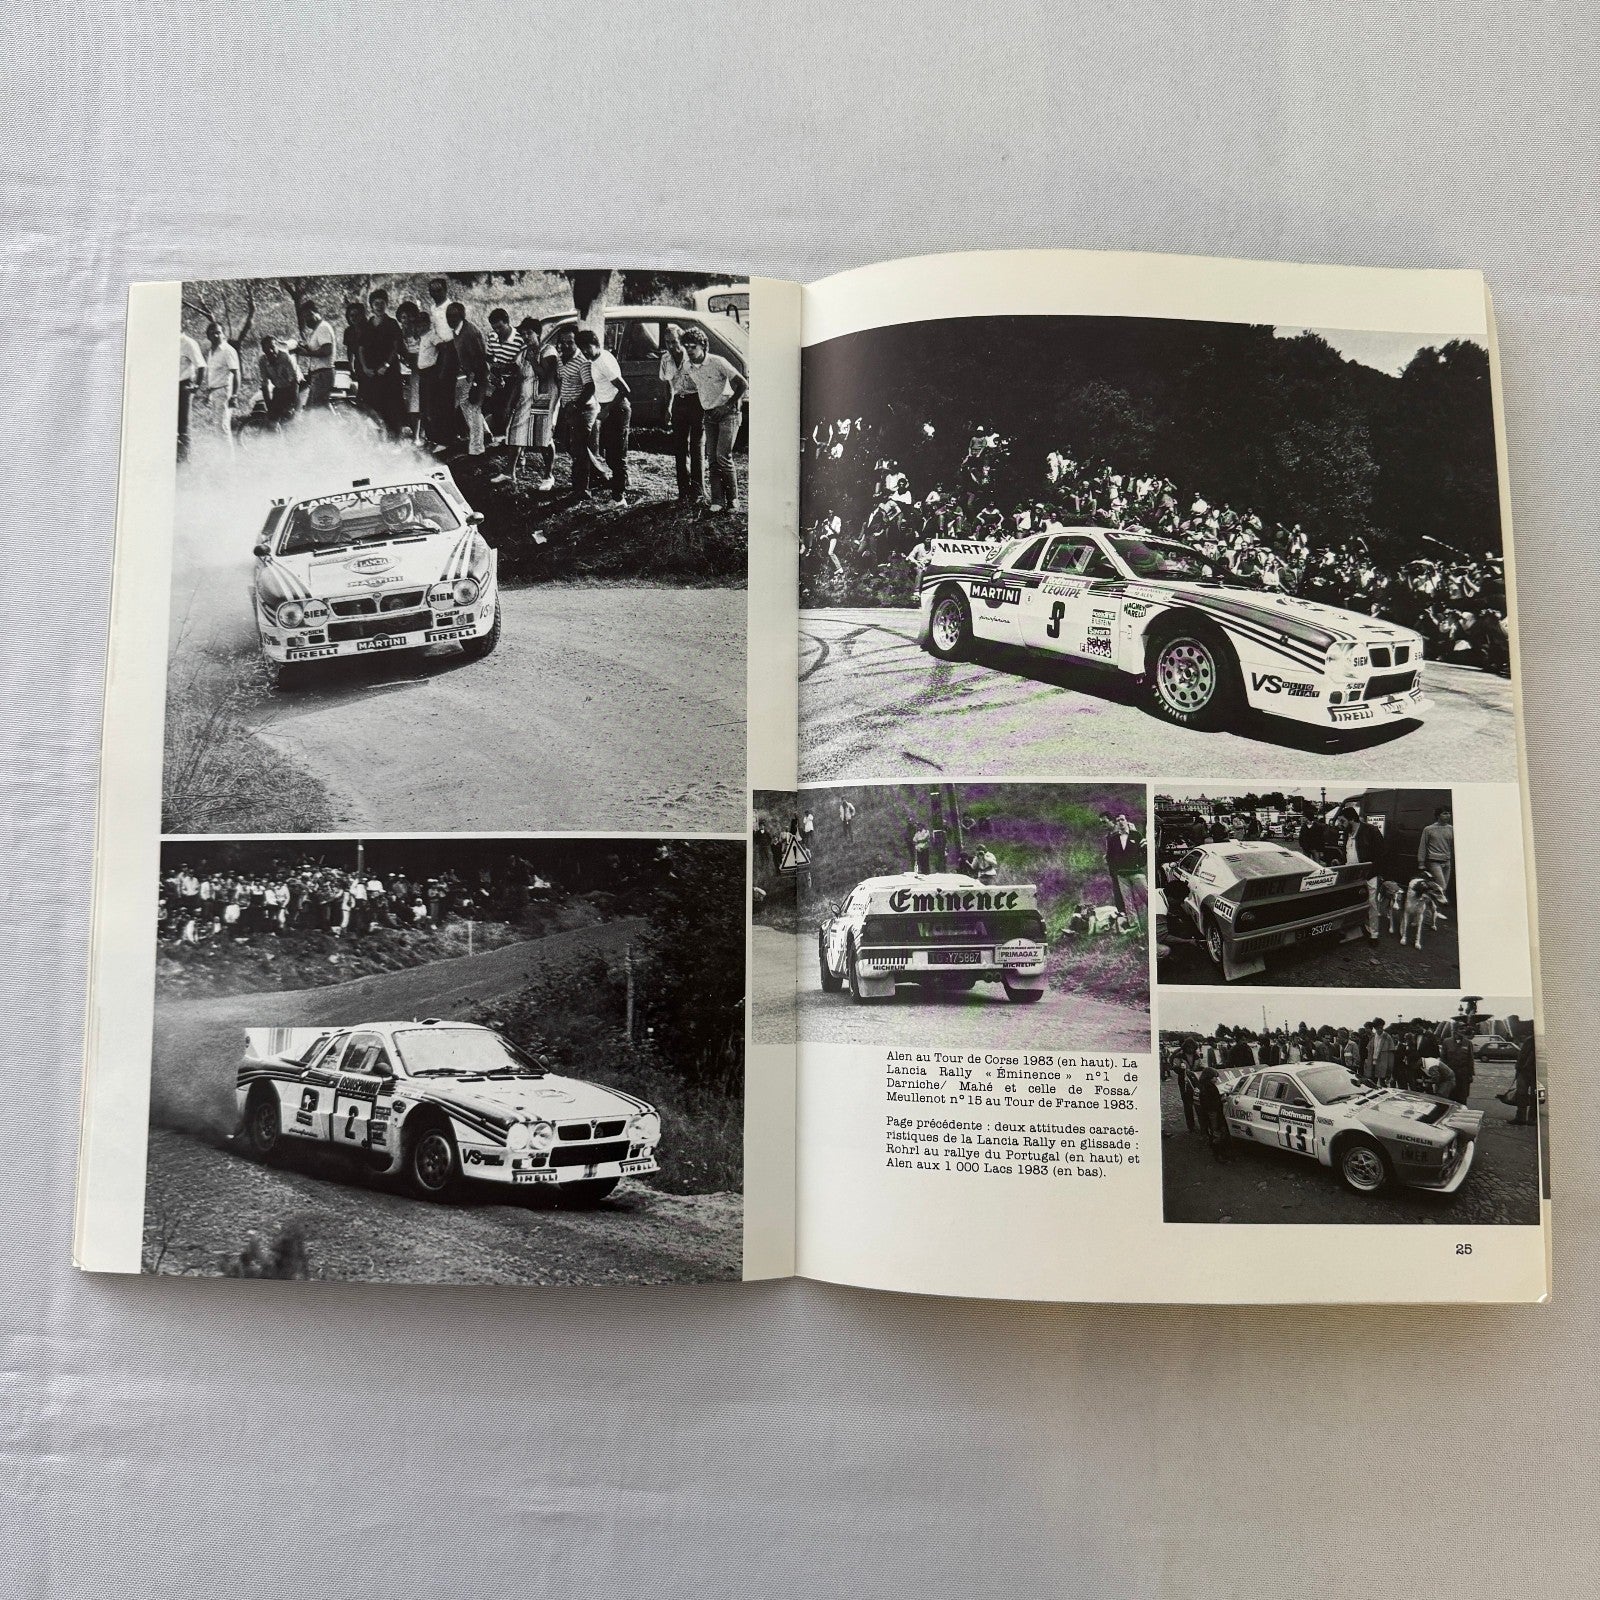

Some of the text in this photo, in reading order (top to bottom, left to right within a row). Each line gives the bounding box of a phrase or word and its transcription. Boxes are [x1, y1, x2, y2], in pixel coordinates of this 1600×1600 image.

[299, 484, 431, 511] LANCIA MARTINI
[357, 557, 389, 568] LANCIA
[971, 584, 1020, 603] MARTINI
[303, 608, 329, 619] SIEM
[424, 624, 477, 642] PIRELLI
[286, 643, 340, 660] PIRELLI
[358, 637, 406, 651] MARTINI
[1251, 671, 1283, 694] VS
[1327, 703, 1374, 722] PIRELLI
[889, 887, 1019, 913] Eminence
[1001, 950, 1039, 958] PRIMAGAZ
[887, 1051, 1138, 1069] Alen au Tour de Corse 1983 (en haut). La
[886, 1064, 927, 1075] Lancia
[939, 1067, 972, 1079] Rally
[996, 1066, 1060, 1080] Éminence
[1124, 1072, 1138, 1083] de
[886, 1078, 1137, 1096] Darniche/ Mahé et celle de Fossa/
[886, 1091, 946, 1103] Meullenot
[986, 1098, 1001, 1106] au
[1004, 1097, 1034, 1107] Tour
[1038, 1098, 1052, 1107] de
[1055, 1097, 1099, 1109] France
[1103, 1099, 1137, 1110] 1983.
[344, 1105, 359, 1140] 2
[1280, 1108, 1314, 1121] Rothmans
[886, 1116, 912, 1128] Page
[916, 1119, 983, 1130] précédente
[995, 1122, 1026, 1132] deux
[1030, 1123, 1085, 1134] attitudes
[1089, 1126, 1138, 1135] caracté-
[886, 1130, 938, 1143] ristiques
[943, 1133, 958, 1143] de
[961, 1134, 972, 1144] la
[977, 1135, 1019, 1146] Lancia
[1023, 1137, 1056, 1149] Rally
[1080, 1138, 1130, 1150] glissade
[1285, 1124, 1308, 1151] 15
[1396, 1133, 1434, 1146] MICHELIN
[886, 1143, 1141, 1165] Rohrl au rallye du Portugal (en haut) et
[886, 1157, 1106, 1178] Alen aux 1 000 Lacs 1983 (en bas).
[1455, 1243, 1473, 1255] 25
